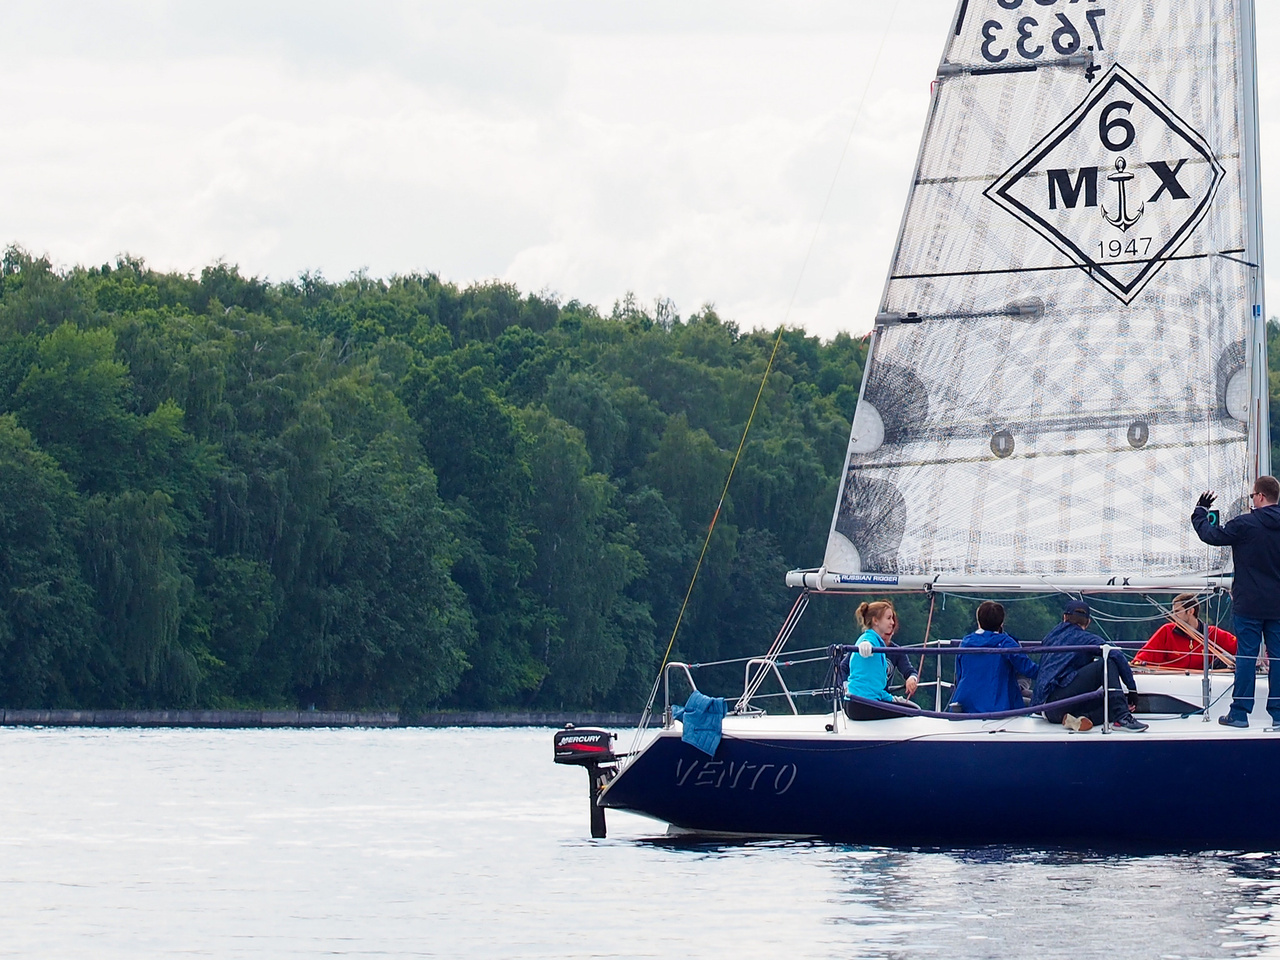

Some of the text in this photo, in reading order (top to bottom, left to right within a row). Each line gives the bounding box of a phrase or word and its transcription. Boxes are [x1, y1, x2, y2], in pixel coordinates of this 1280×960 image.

[1099, 100, 1135, 152] 6
[1098, 237, 1153, 258] 1947
[559, 734, 601, 744] MERCURY
[676, 758, 797, 795] VENTO
